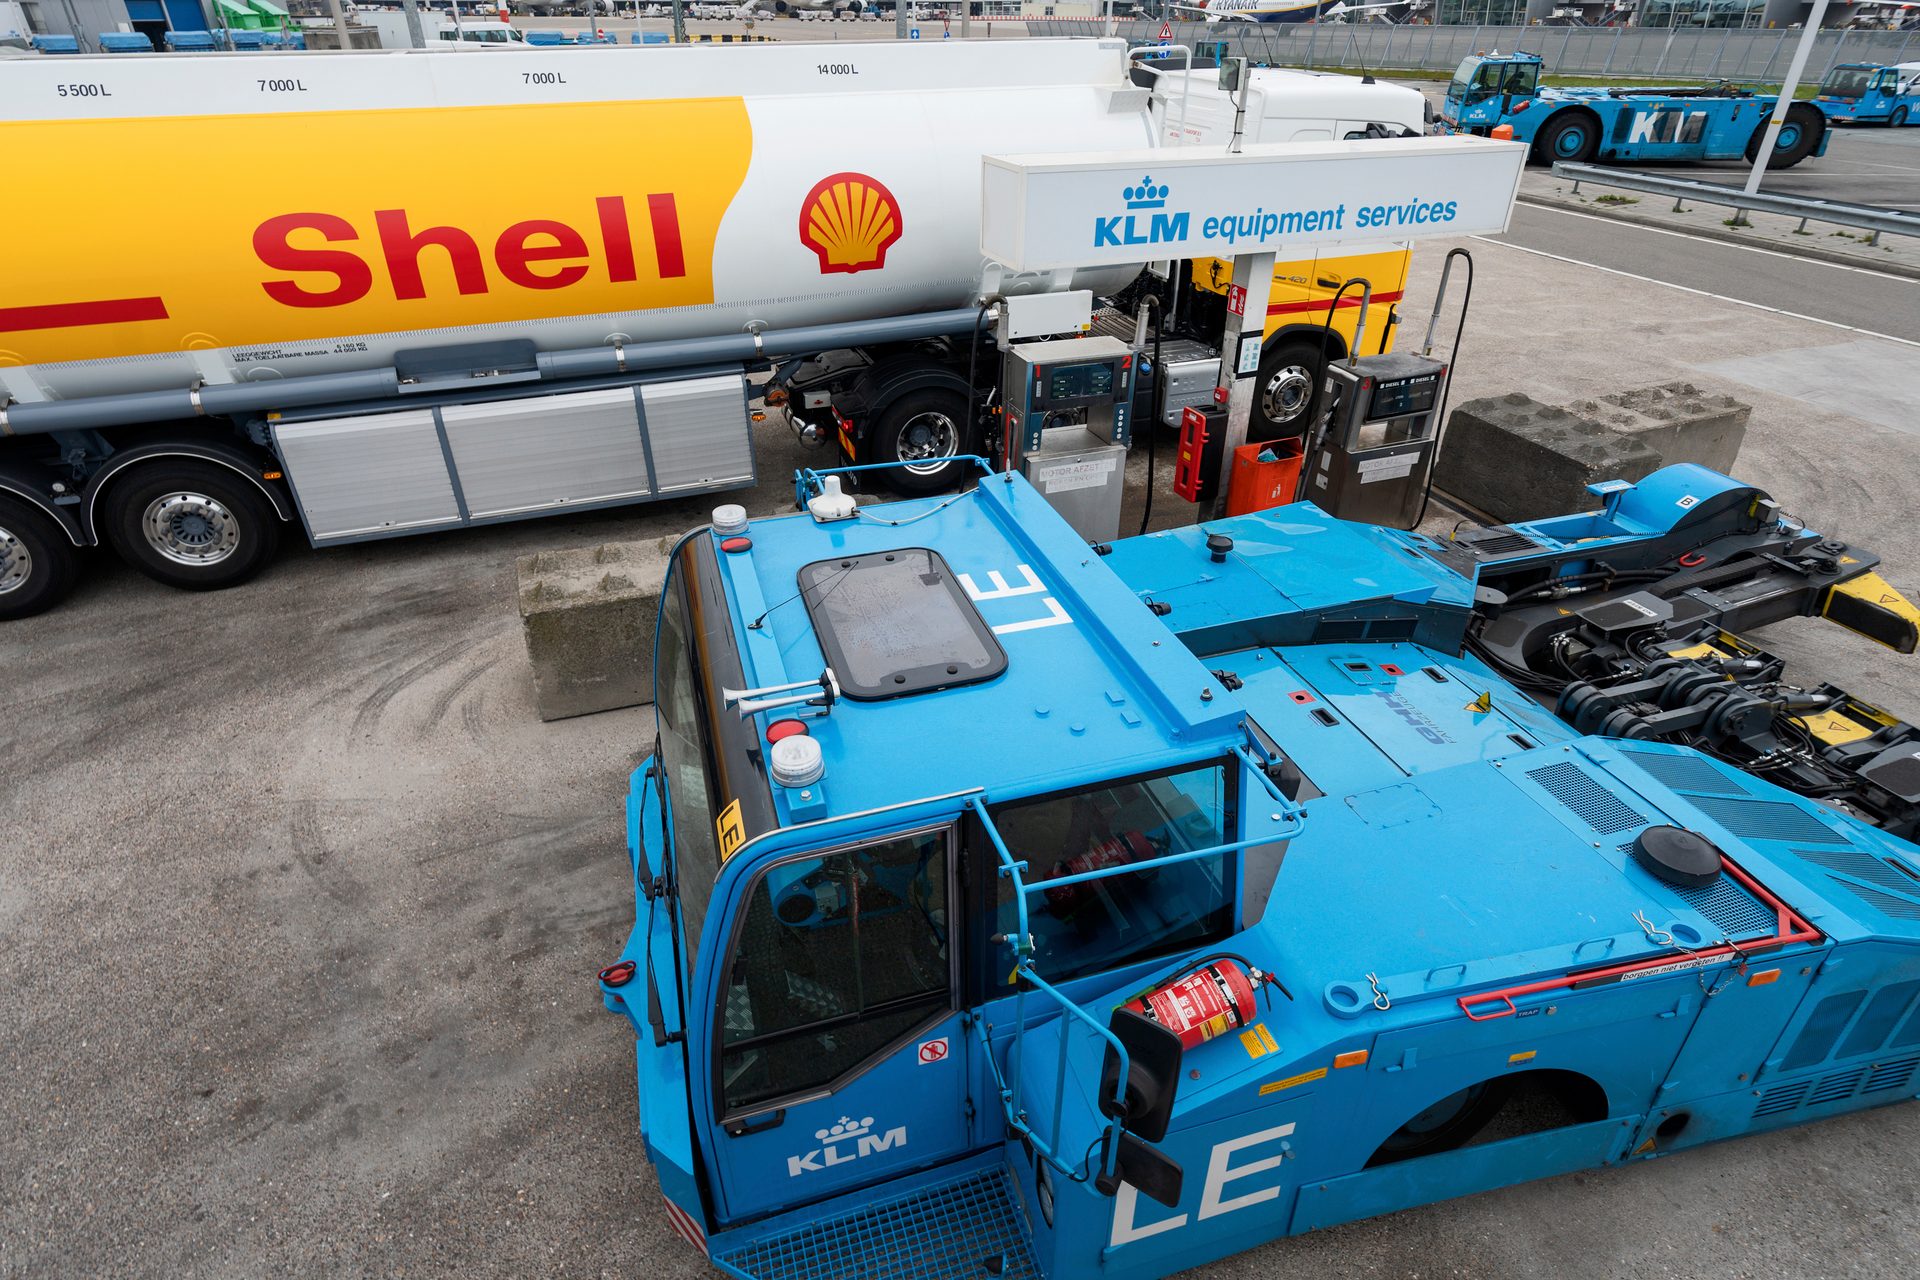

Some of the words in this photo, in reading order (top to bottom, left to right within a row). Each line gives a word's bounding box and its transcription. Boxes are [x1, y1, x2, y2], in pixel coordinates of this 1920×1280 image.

[1215, 0, 1259, 10] RYANAIR
[1094, 211, 1190, 248] KLM
[1202, 203, 1346, 244] equipment
[1355, 197, 1458, 228] services
[252, 193, 686, 308] Shell
[1287, 275, 1307, 284] 420
[232, 349, 282, 358] LEEGGEWICHT
[255, 352, 303, 361] TOELAATBARE
[1121, 355, 1133, 369] 2
[1034, 364, 1041, 378] 1
[1361, 376, 1371, 391] 3
[1680, 497, 1693, 506] B
[957, 564, 1074, 635] LE
[720, 805, 740, 854] LE
[1623, 968, 1659, 980] borgpen
[1660, 964, 1677, 973] niet
[1518, 1009, 1539, 1017] TRAP
[787, 1125, 907, 1177] KLM
[1110, 1122, 1296, 1247] LE
